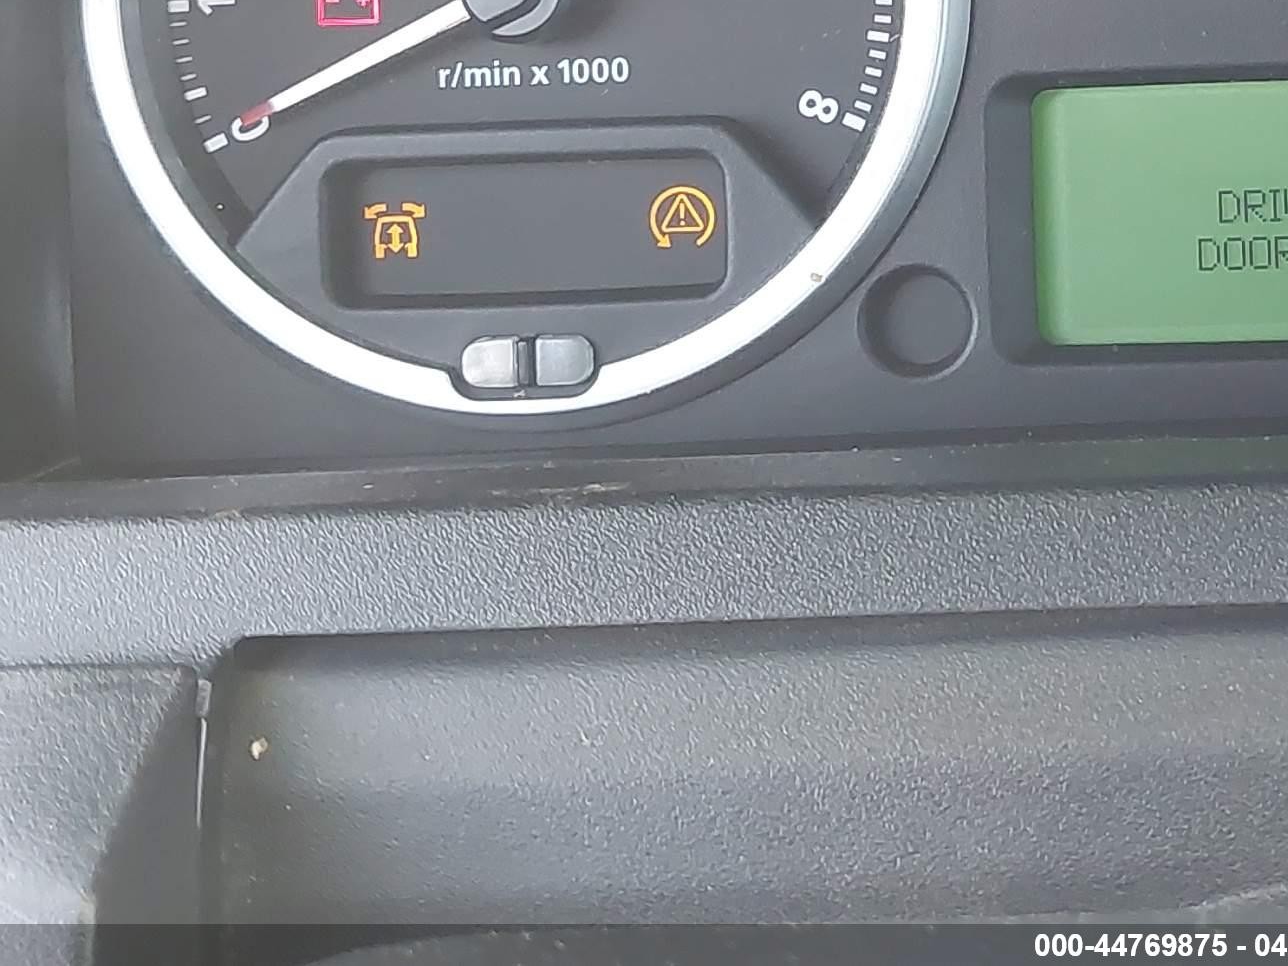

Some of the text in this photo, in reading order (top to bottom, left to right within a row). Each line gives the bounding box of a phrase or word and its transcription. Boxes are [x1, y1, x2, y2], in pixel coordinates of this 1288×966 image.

[438, 57, 629, 88] r/min x 1000
[798, 90, 839, 124] 8
